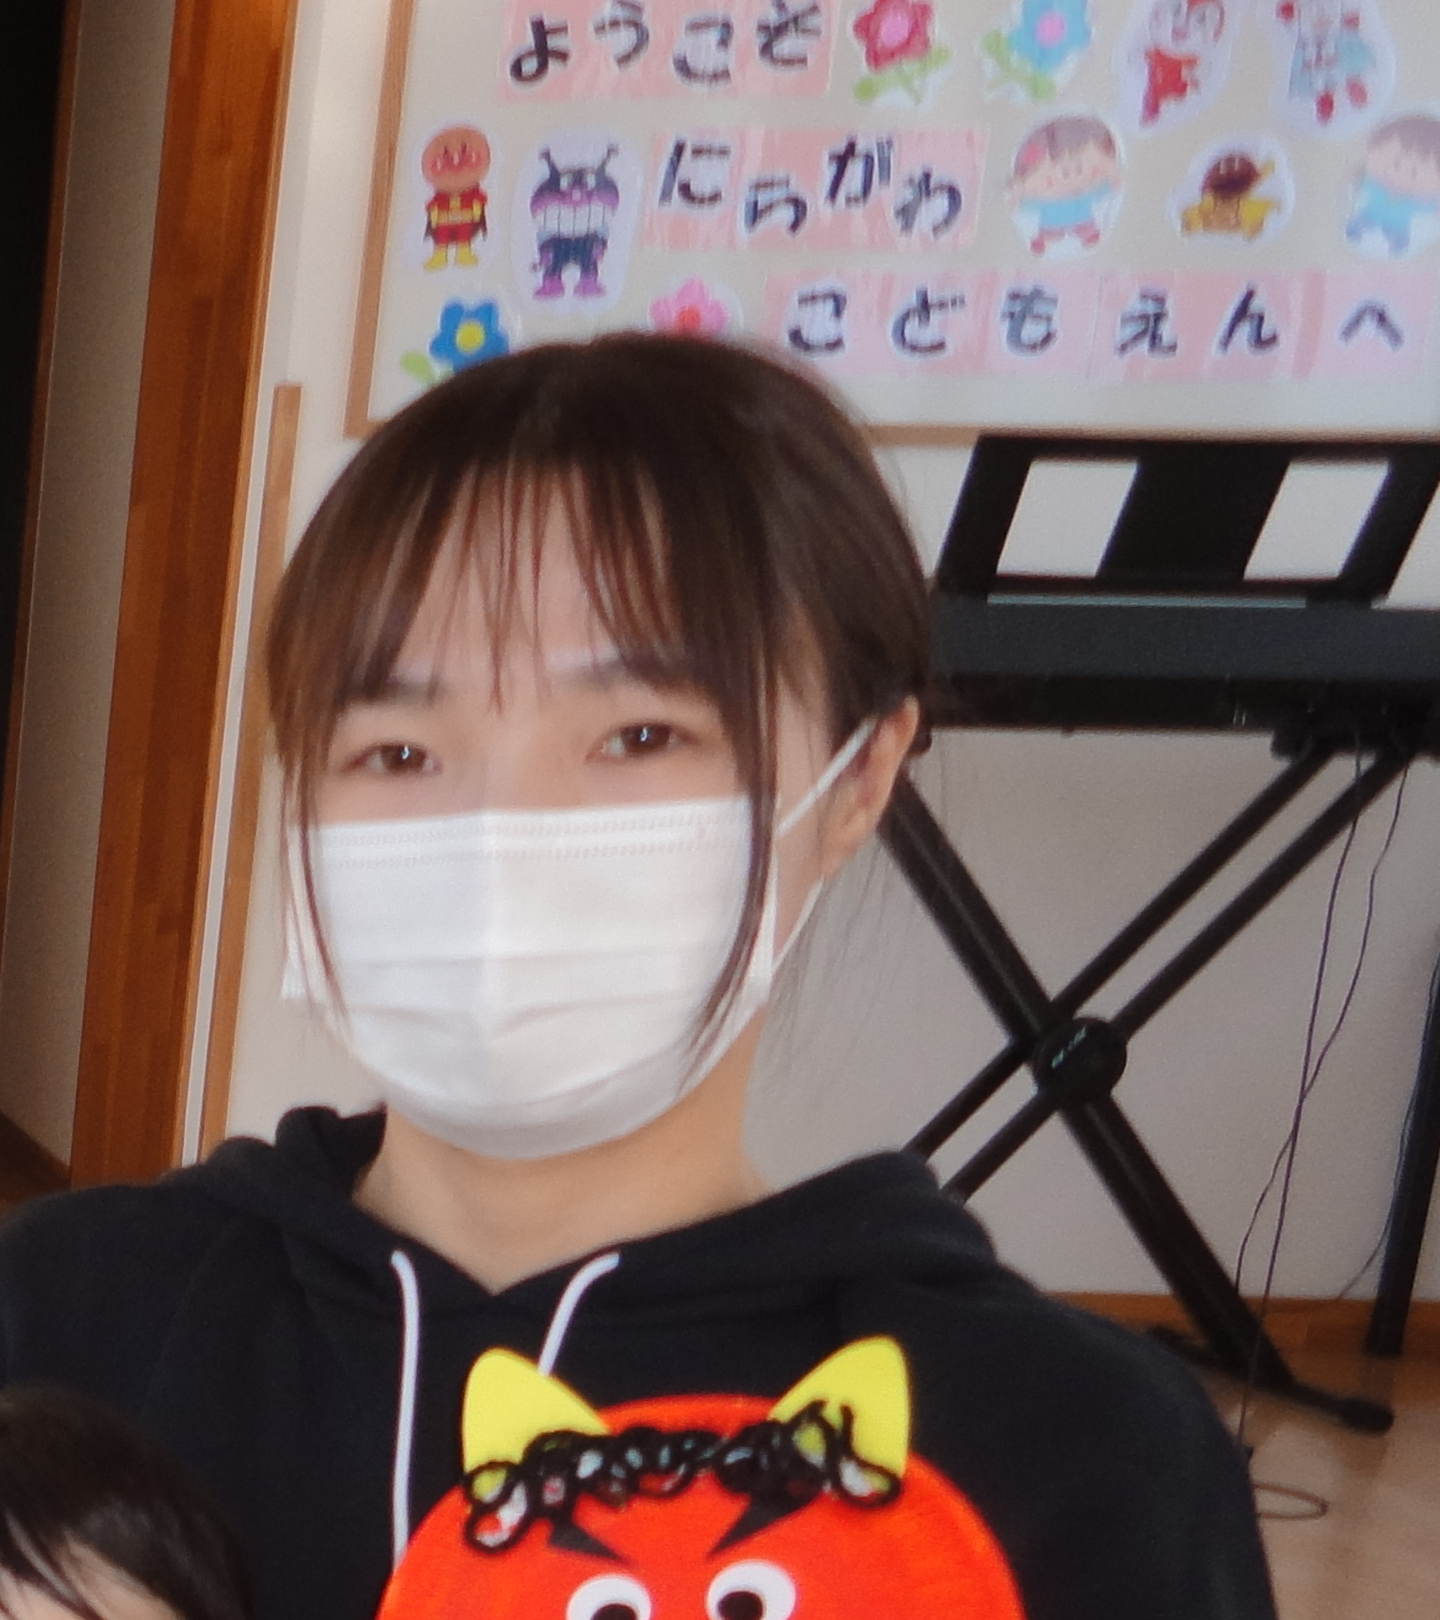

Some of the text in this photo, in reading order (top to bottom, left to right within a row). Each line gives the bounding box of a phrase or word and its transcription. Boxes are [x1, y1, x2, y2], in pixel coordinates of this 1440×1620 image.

[509, 0, 822, 83] ようこそ
[658, 137, 962, 239] にらがわ
[788, 286, 1404, 353] こどもえんへ
